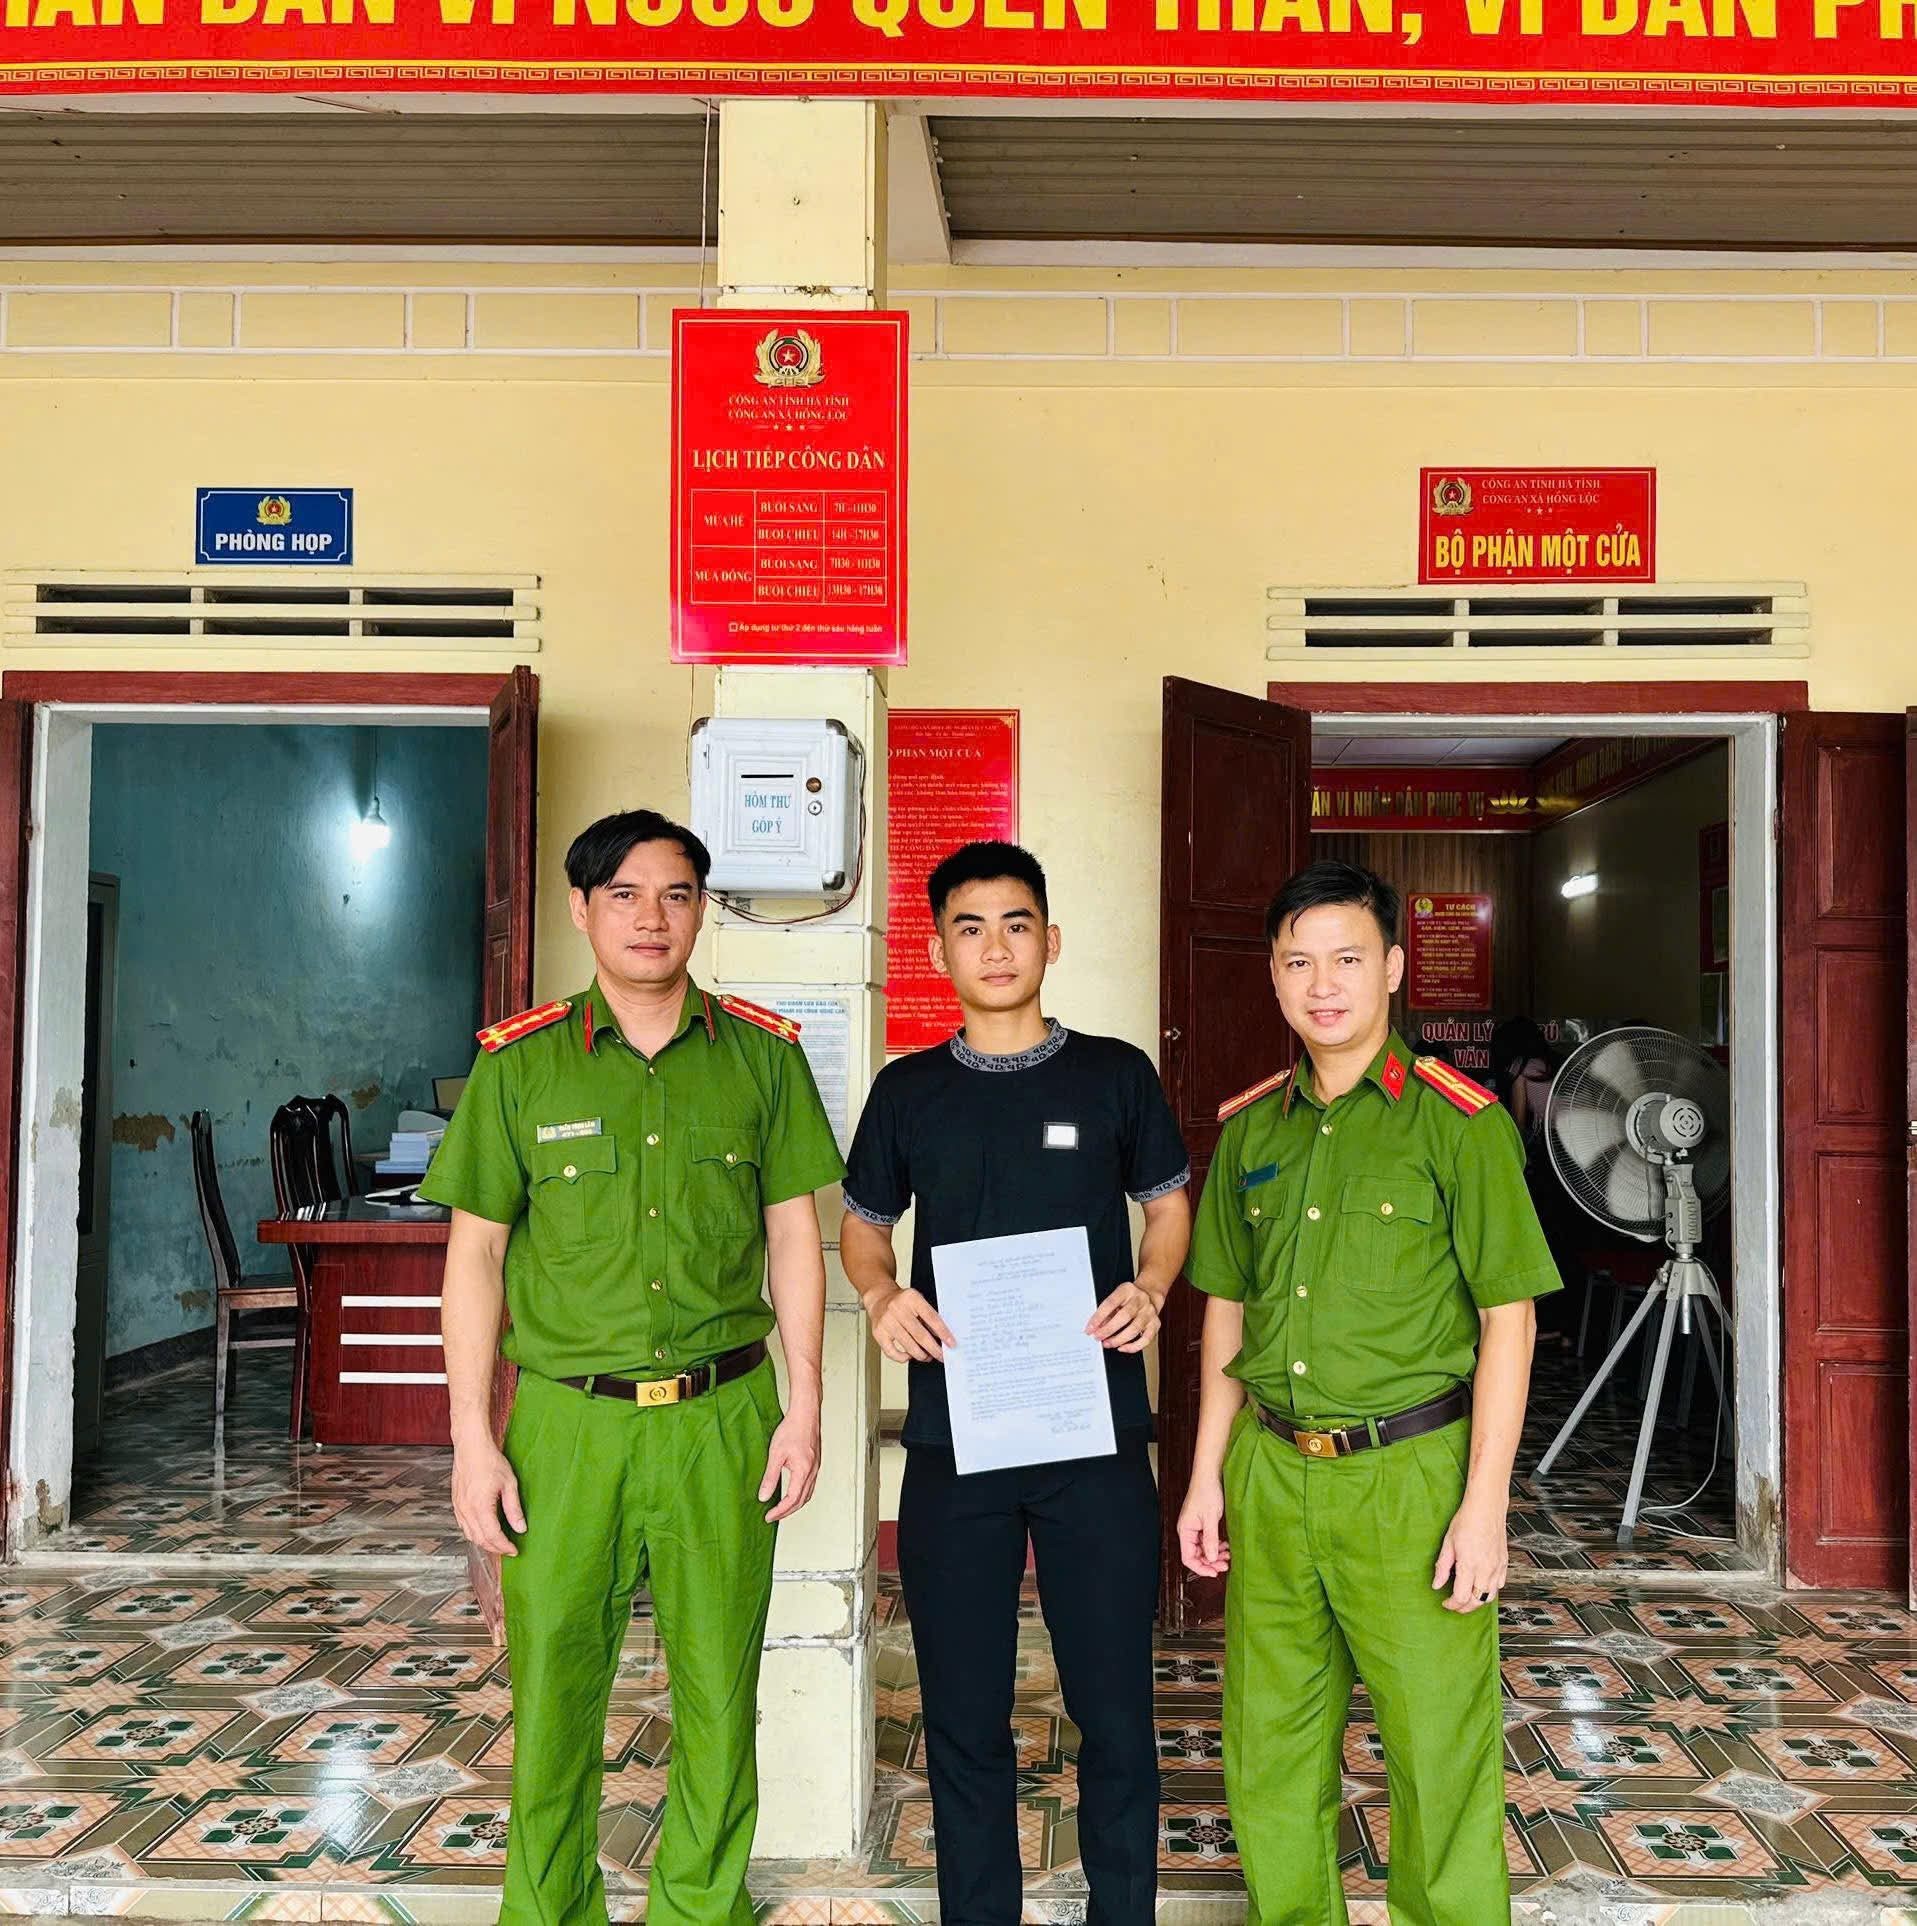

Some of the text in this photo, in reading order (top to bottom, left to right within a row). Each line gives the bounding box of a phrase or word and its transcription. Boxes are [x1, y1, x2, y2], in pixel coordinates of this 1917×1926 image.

[693, 450, 738, 473] LỊCH
[788, 444, 842, 469] CÔNG
[847, 444, 885, 469] DÂN
[1513, 479, 1528, 489] AN
[1513, 494, 1528, 504] AN
[1546, 489, 1577, 504] HỒNG
[1579, 491, 1600, 506] LỘC
[215, 529, 333, 555] PHÒNG HỌP
[1436, 523, 1641, 575] BỘ PHẬN MỘT CỬA
[744, 791, 792, 809] HÒM THƯ
[752, 816, 784, 834] GÓP Ý
[1421, 1016, 1470, 1043] QUẢN
[1473, 1018, 1495, 1042] LÝ
